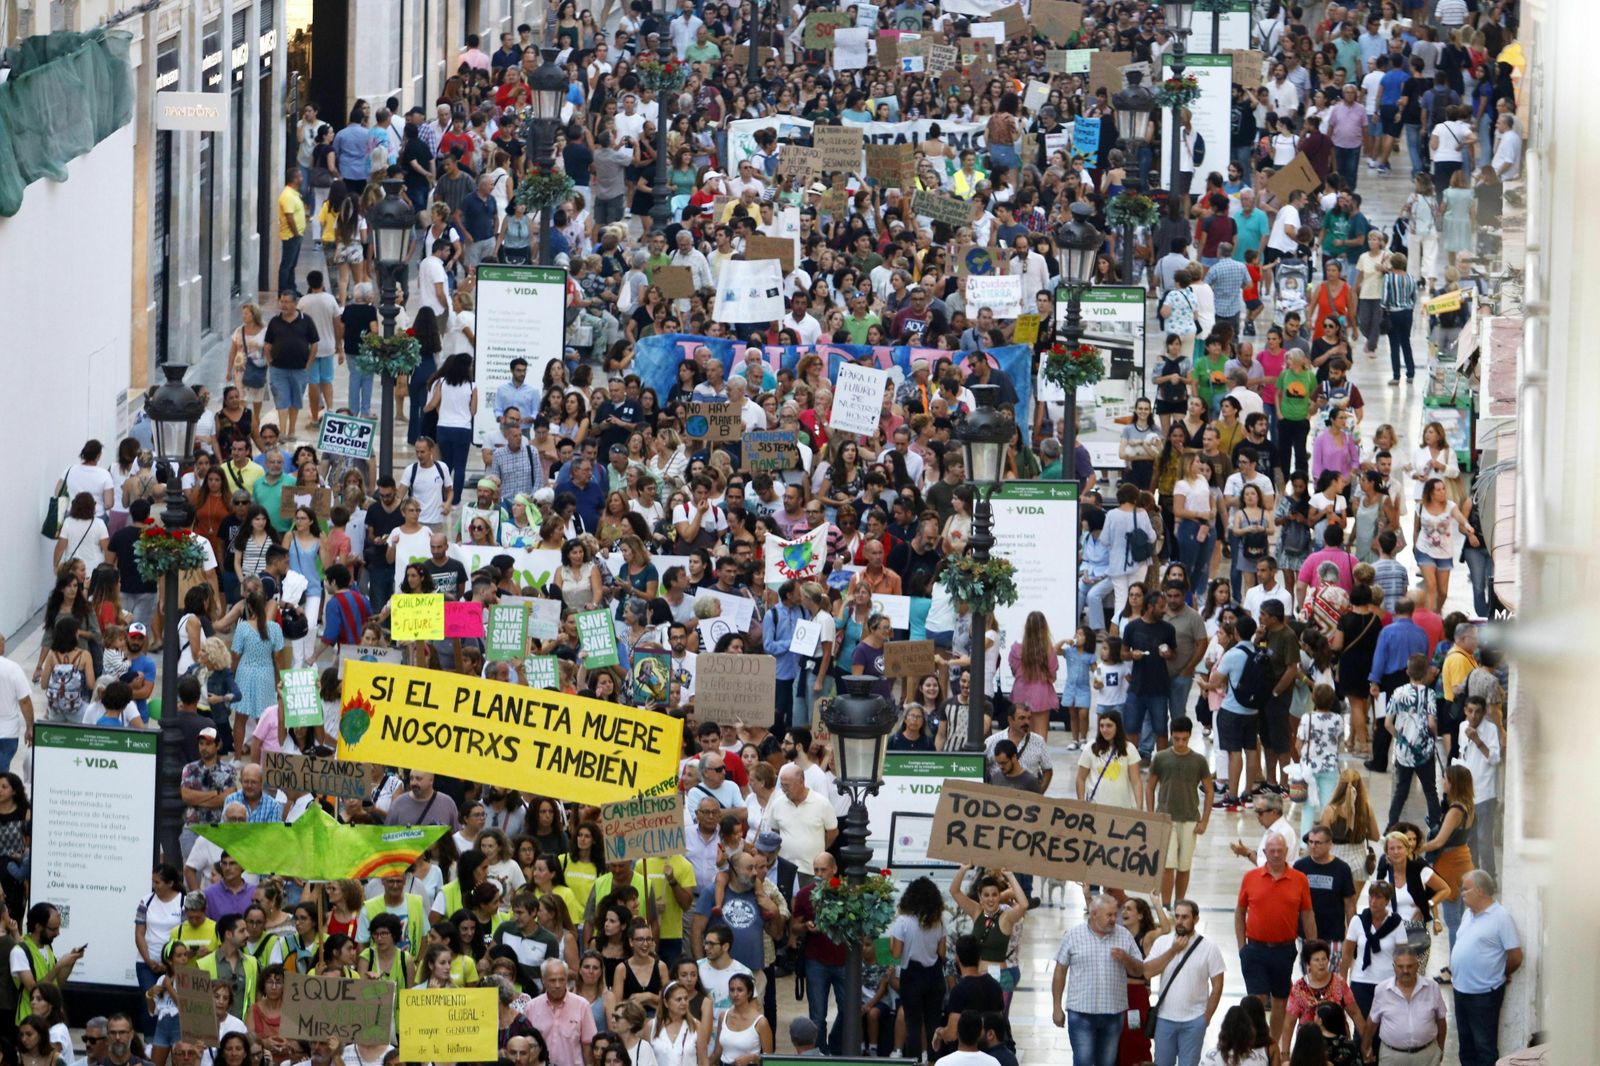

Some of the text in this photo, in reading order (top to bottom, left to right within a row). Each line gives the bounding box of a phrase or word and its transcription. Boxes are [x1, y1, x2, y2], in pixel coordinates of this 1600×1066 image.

[164, 104, 219, 118] PANDORA
[687, 403, 730, 414] NO HAY
[709, 415, 740, 426] PLANETA
[720, 425, 730, 436] B
[323, 435, 368, 450] ECOCIDE
[758, 441, 796, 452] SISTEMA
[751, 458, 790, 472] PLANETA
[1016, 506, 1045, 515] VIDA
[397, 597, 435, 609] CHILDREN
[495, 608, 523, 622] SAVE
[579, 612, 608, 629] SAVE
[403, 619, 432, 632] FUTURE
[493, 630, 521, 643] SAVE
[582, 634, 612, 651] SAVE
[525, 659, 554, 673] SAVE
[284, 671, 316, 687] SAVE
[287, 694, 317, 709] SAVE
[370, 675, 664, 755] SI EL PLANETA MUERE
[381, 715, 638, 789] NOSOTRXS TAMBIÉN
[85, 757, 118, 769] VIDA
[266, 752, 365, 778] NOS ALZAMOS
[266, 769, 317, 793] COMO EL
[50, 788, 83, 796] Investigar
[910, 784, 942, 794] VIDA
[60, 799, 103, 808] determinado
[603, 797, 676, 820] CAMBIEMOS
[948, 792, 1147, 842] TODOS POR LA
[605, 815, 678, 836] el sistema
[605, 836, 626, 860] NO
[643, 826, 686, 854] CLIMA
[947, 820, 1160, 876] REFORESTACIÓN
[47, 881, 65, 889] ¿Qué
[109, 885, 127, 894] hoy?
[177, 974, 209, 992] NO HAY
[291, 978, 356, 1001] ¿QUE
[406, 994, 466, 1007] CALENTAMIENTO
[298, 1014, 362, 1040] MIRAS?
[419, 1027, 439, 1039] mayor
[419, 1043, 472, 1055] de la historia
